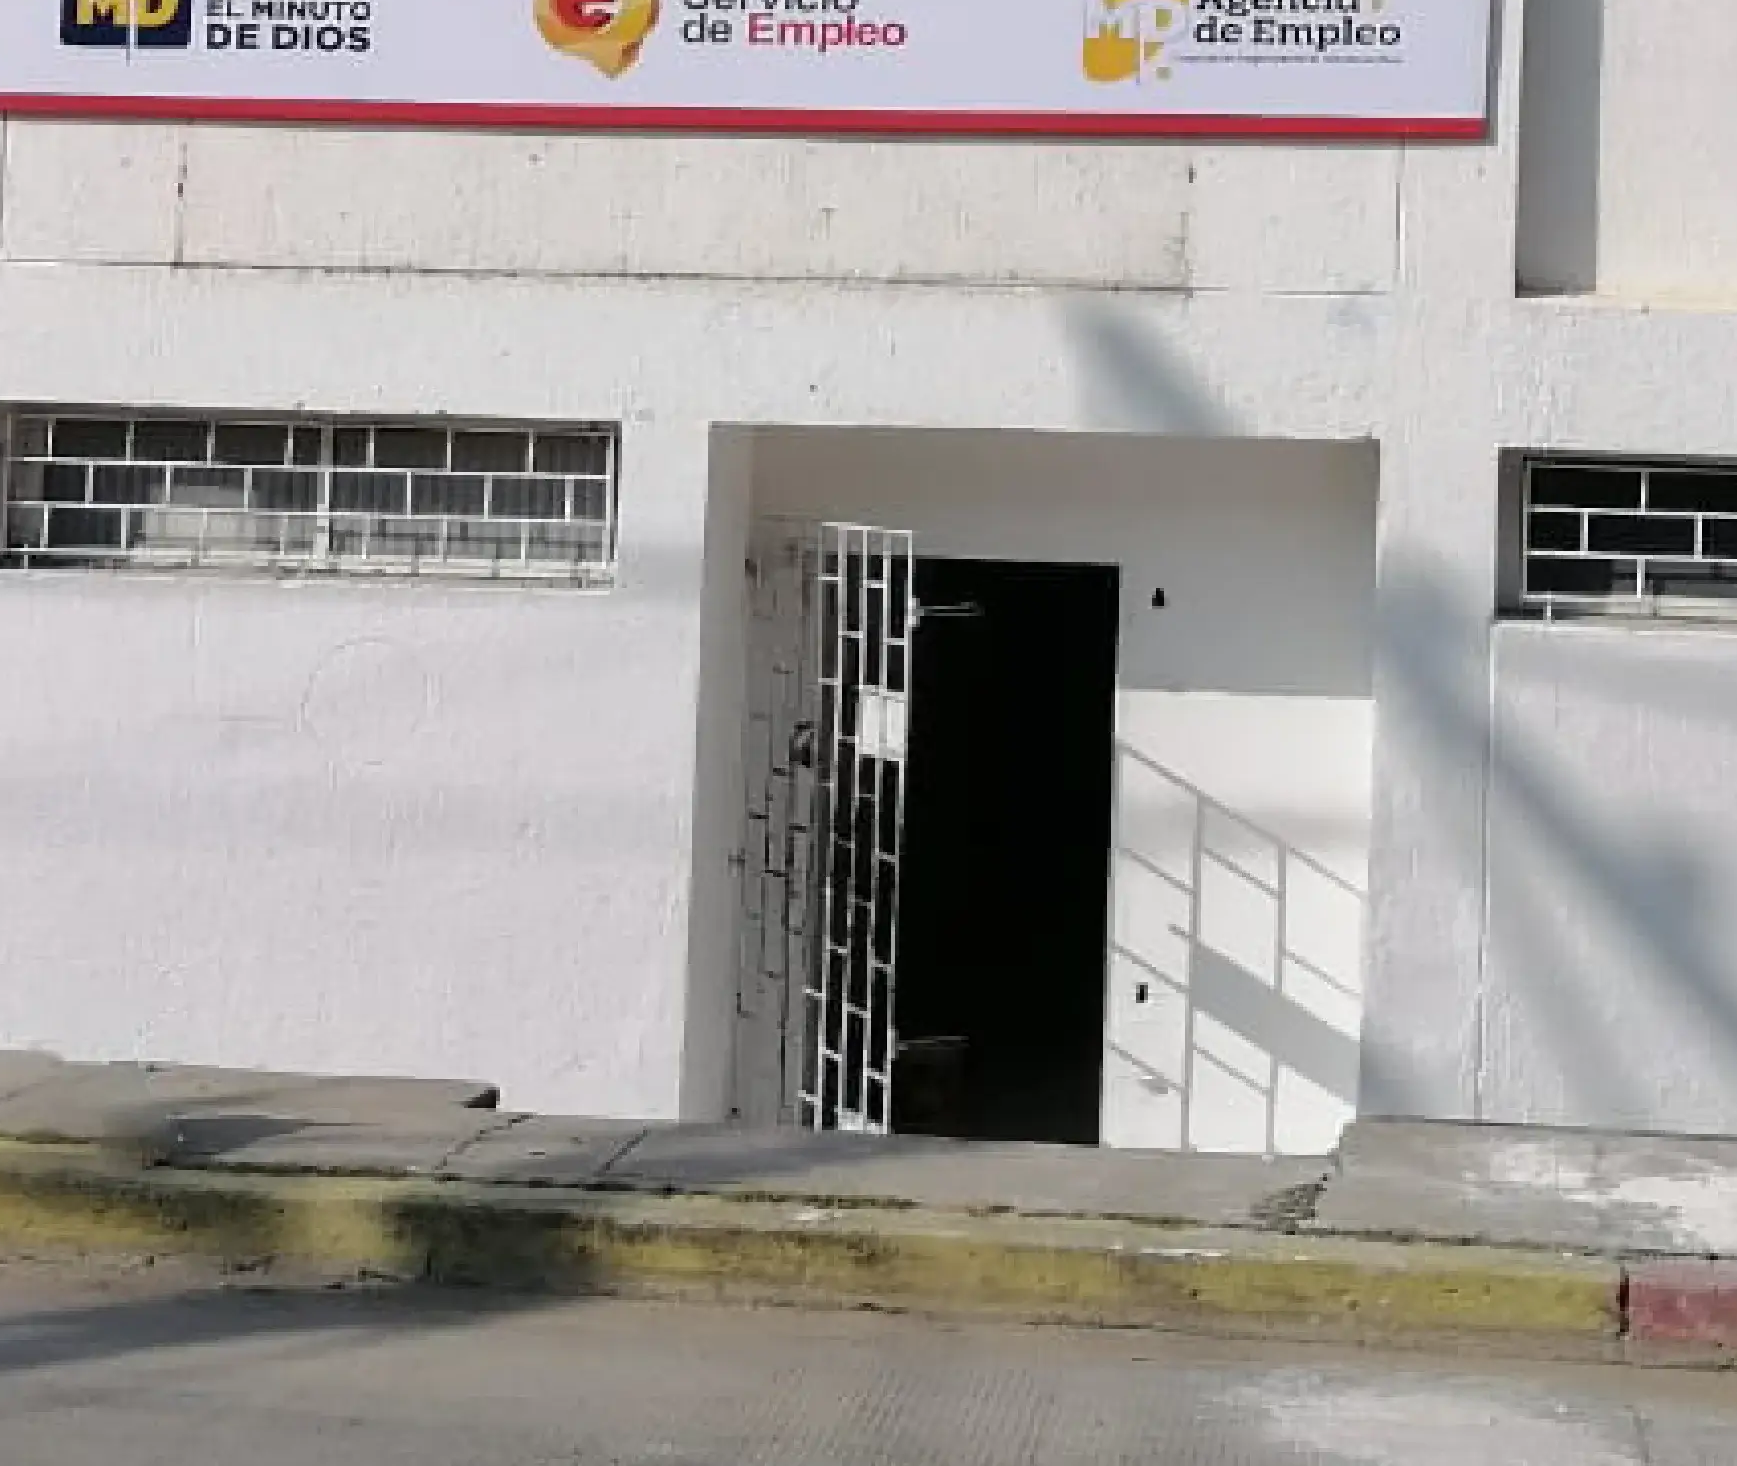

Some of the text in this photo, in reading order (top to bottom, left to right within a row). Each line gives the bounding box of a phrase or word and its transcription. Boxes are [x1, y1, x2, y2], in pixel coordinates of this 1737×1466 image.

[251, 0, 372, 22] MINUTO
[206, 23, 372, 53] DE DIOS
[680, 12, 909, 53] de Empleo
[1192, 16, 1402, 52] de Empleo
